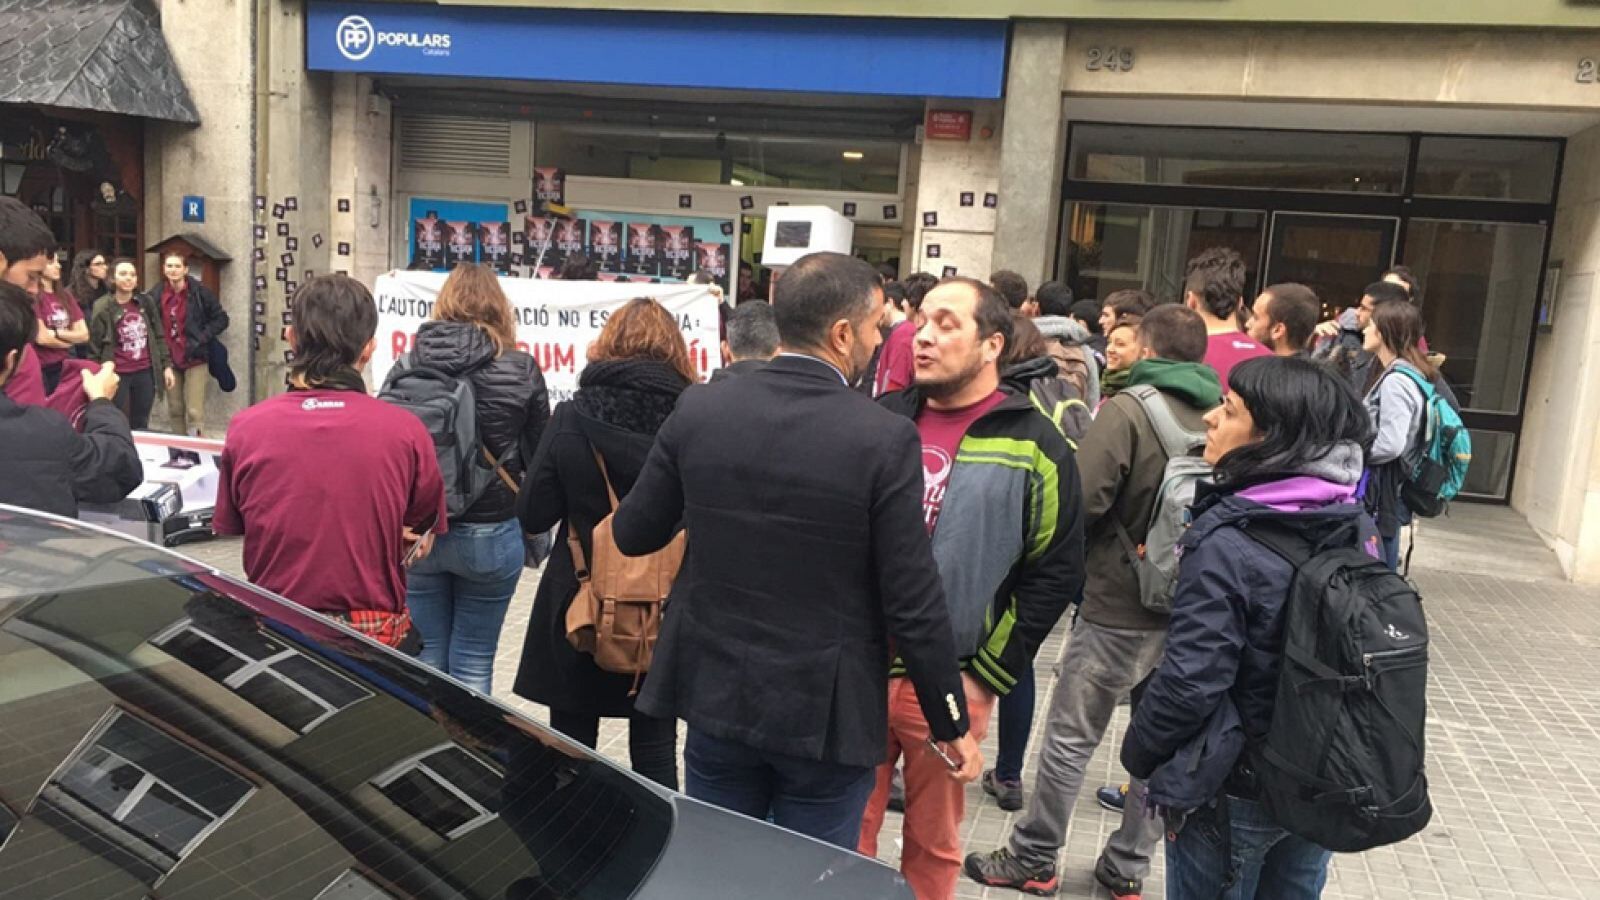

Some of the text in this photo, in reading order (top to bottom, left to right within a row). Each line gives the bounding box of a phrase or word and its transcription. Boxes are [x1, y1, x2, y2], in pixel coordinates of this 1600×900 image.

[377, 31, 451, 48] POPULARS
[1086, 48, 1135, 72] 249
[189, 202, 199, 216] R
[559, 310, 581, 328] NO
